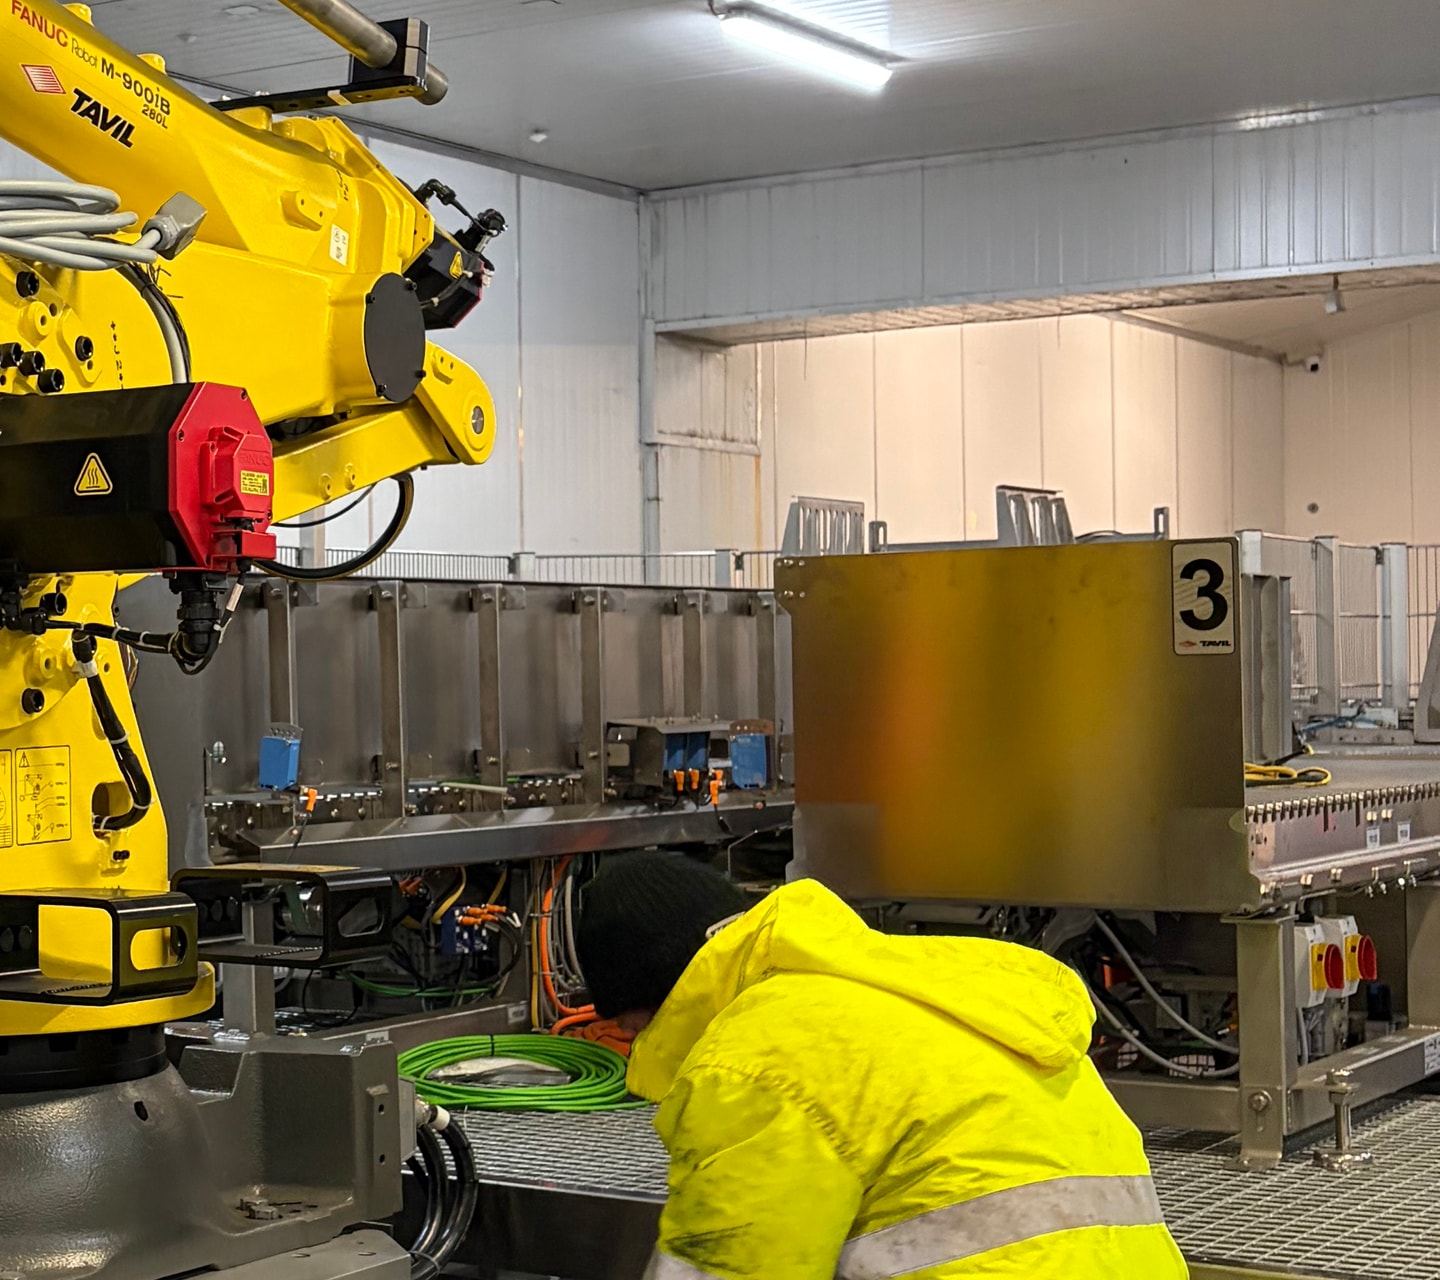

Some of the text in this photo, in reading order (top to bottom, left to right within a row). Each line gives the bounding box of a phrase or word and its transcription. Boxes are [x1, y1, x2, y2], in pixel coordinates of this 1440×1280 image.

[71, 37, 98, 69] Robot
[70, 87, 135, 148] TAVIL
[141, 104, 169, 129] 280L
[1180, 559, 1228, 631] 3
